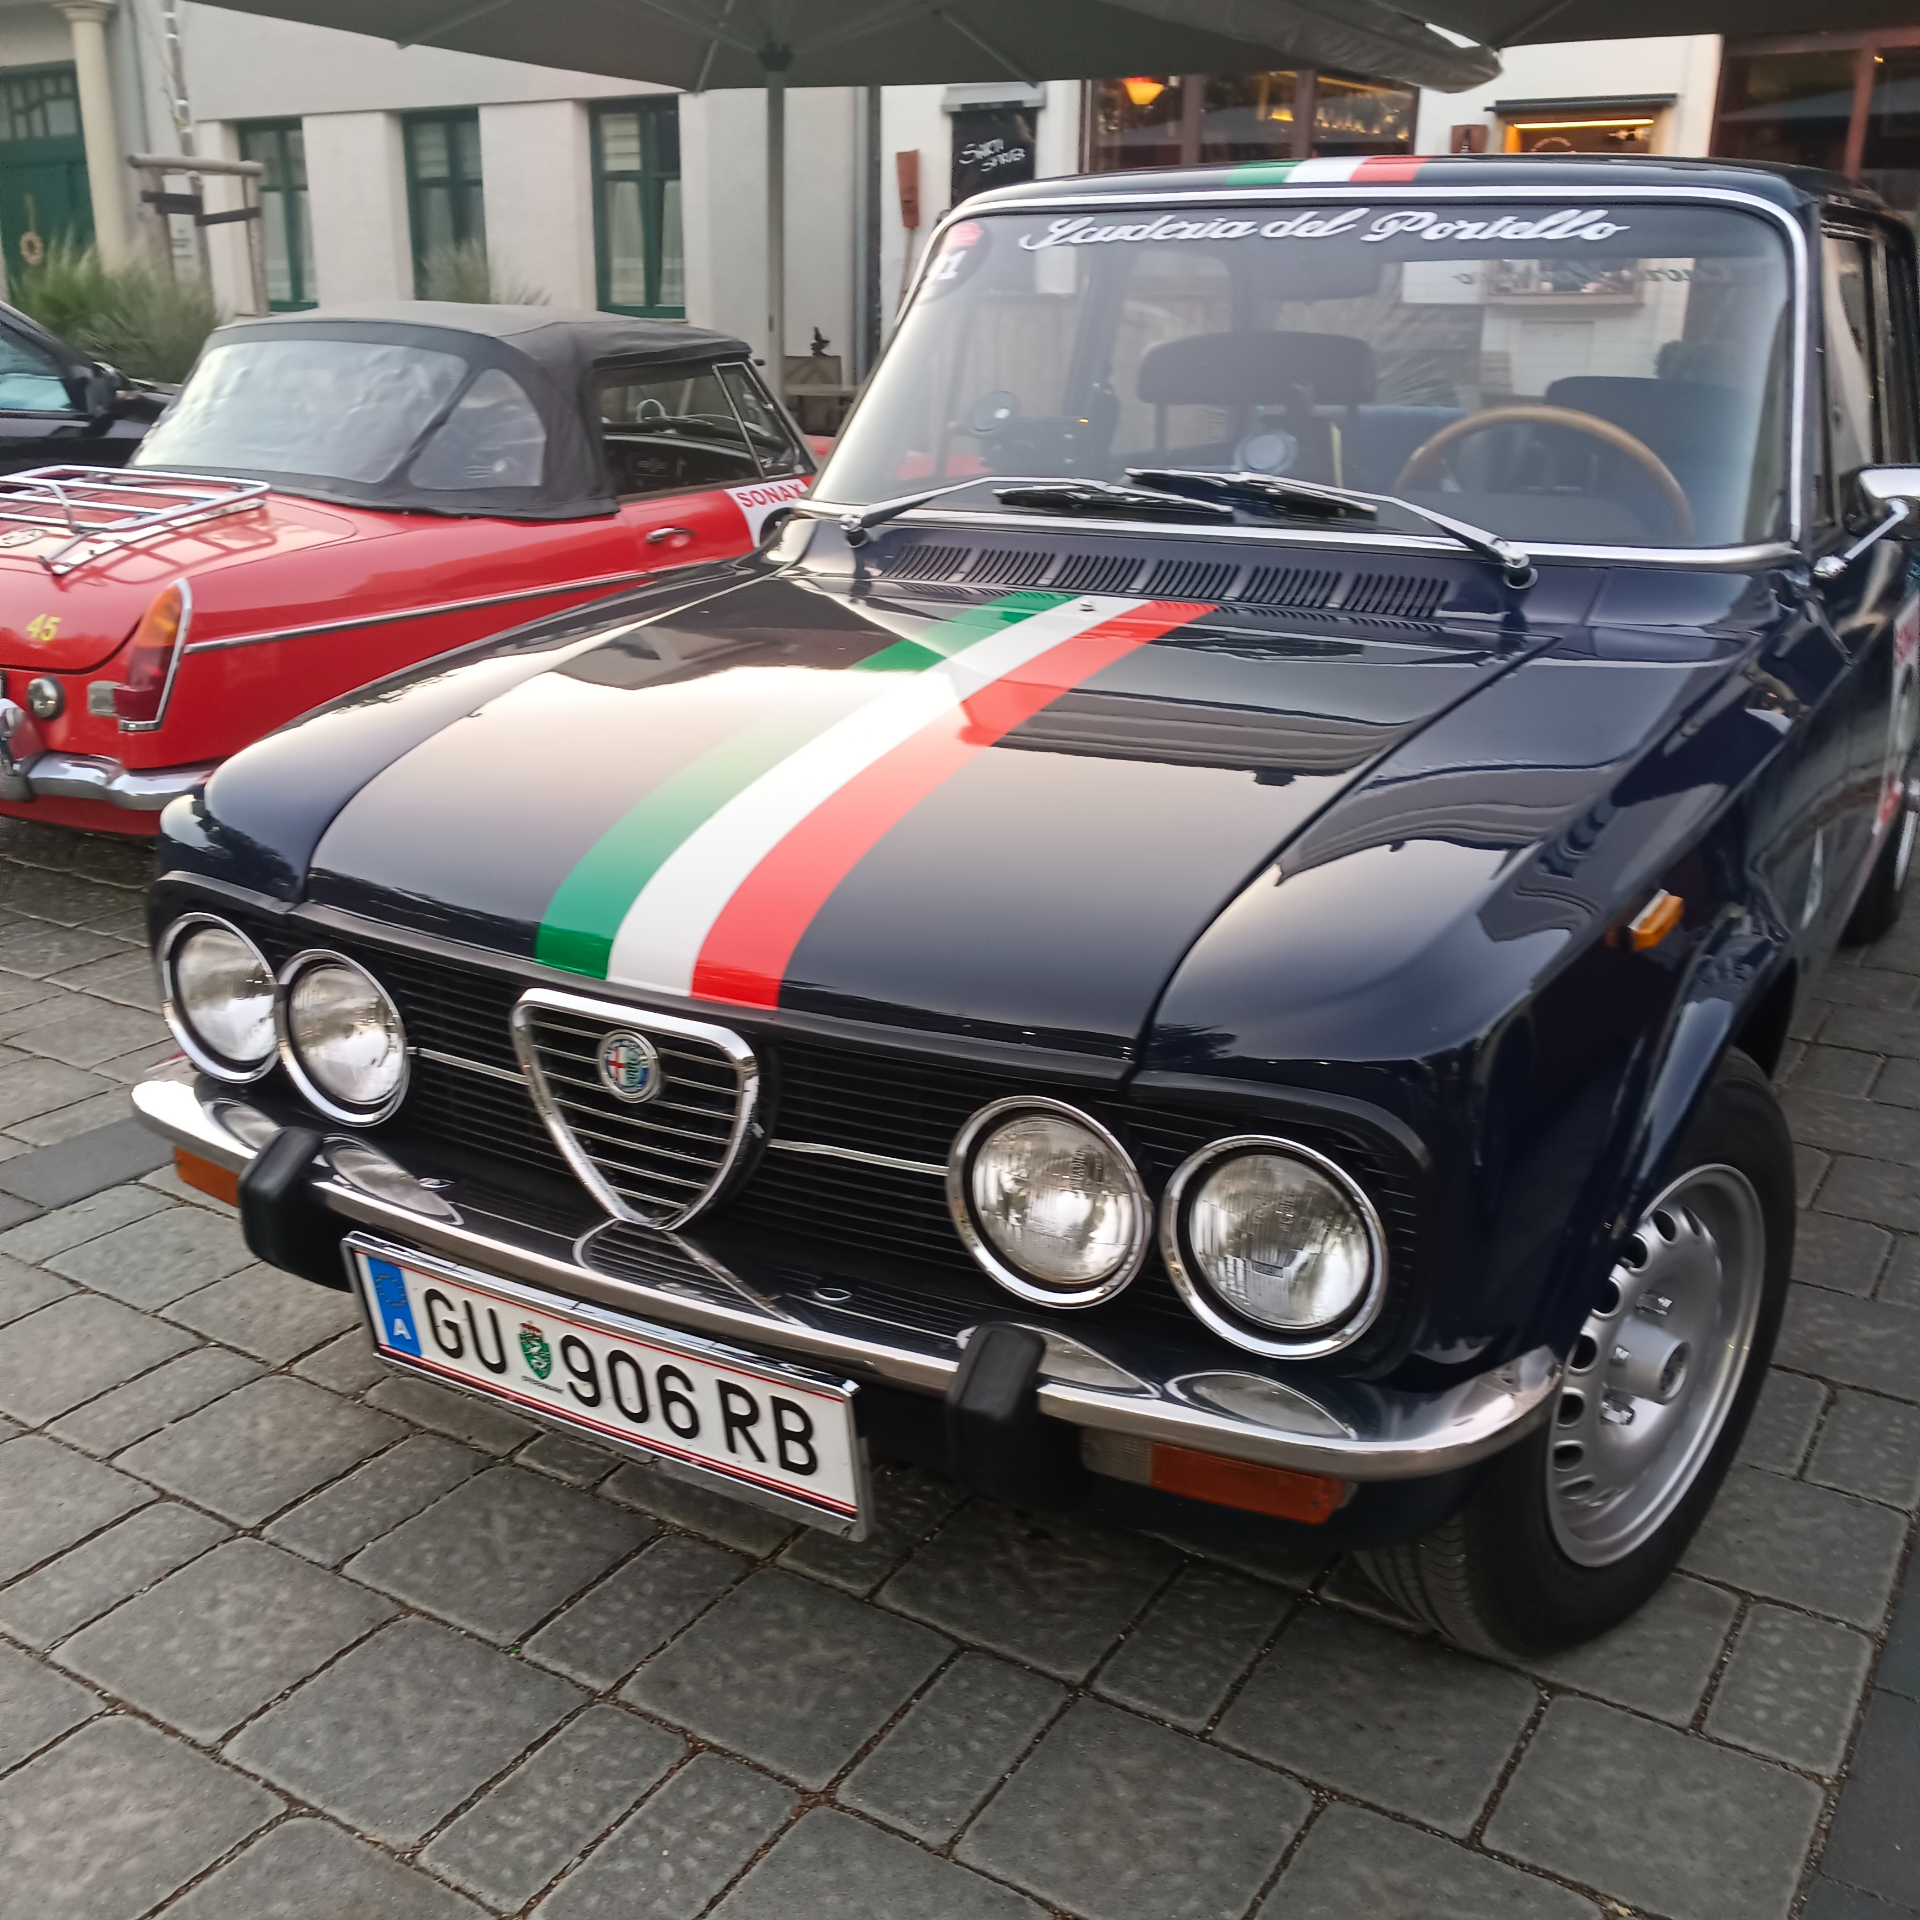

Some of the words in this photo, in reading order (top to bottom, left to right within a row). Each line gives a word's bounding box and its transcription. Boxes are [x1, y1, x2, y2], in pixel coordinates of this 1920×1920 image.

[1018, 214, 1258, 250] Scuderia
[1259, 207, 1371, 238] del
[1360, 208, 1631, 242] Portello
[26, 613, 62, 642] 45
[393, 1318, 412, 1340] A
[424, 1288, 507, 1374] GU
[560, 1334, 700, 1440] 906
[715, 1378, 818, 1476] RB
